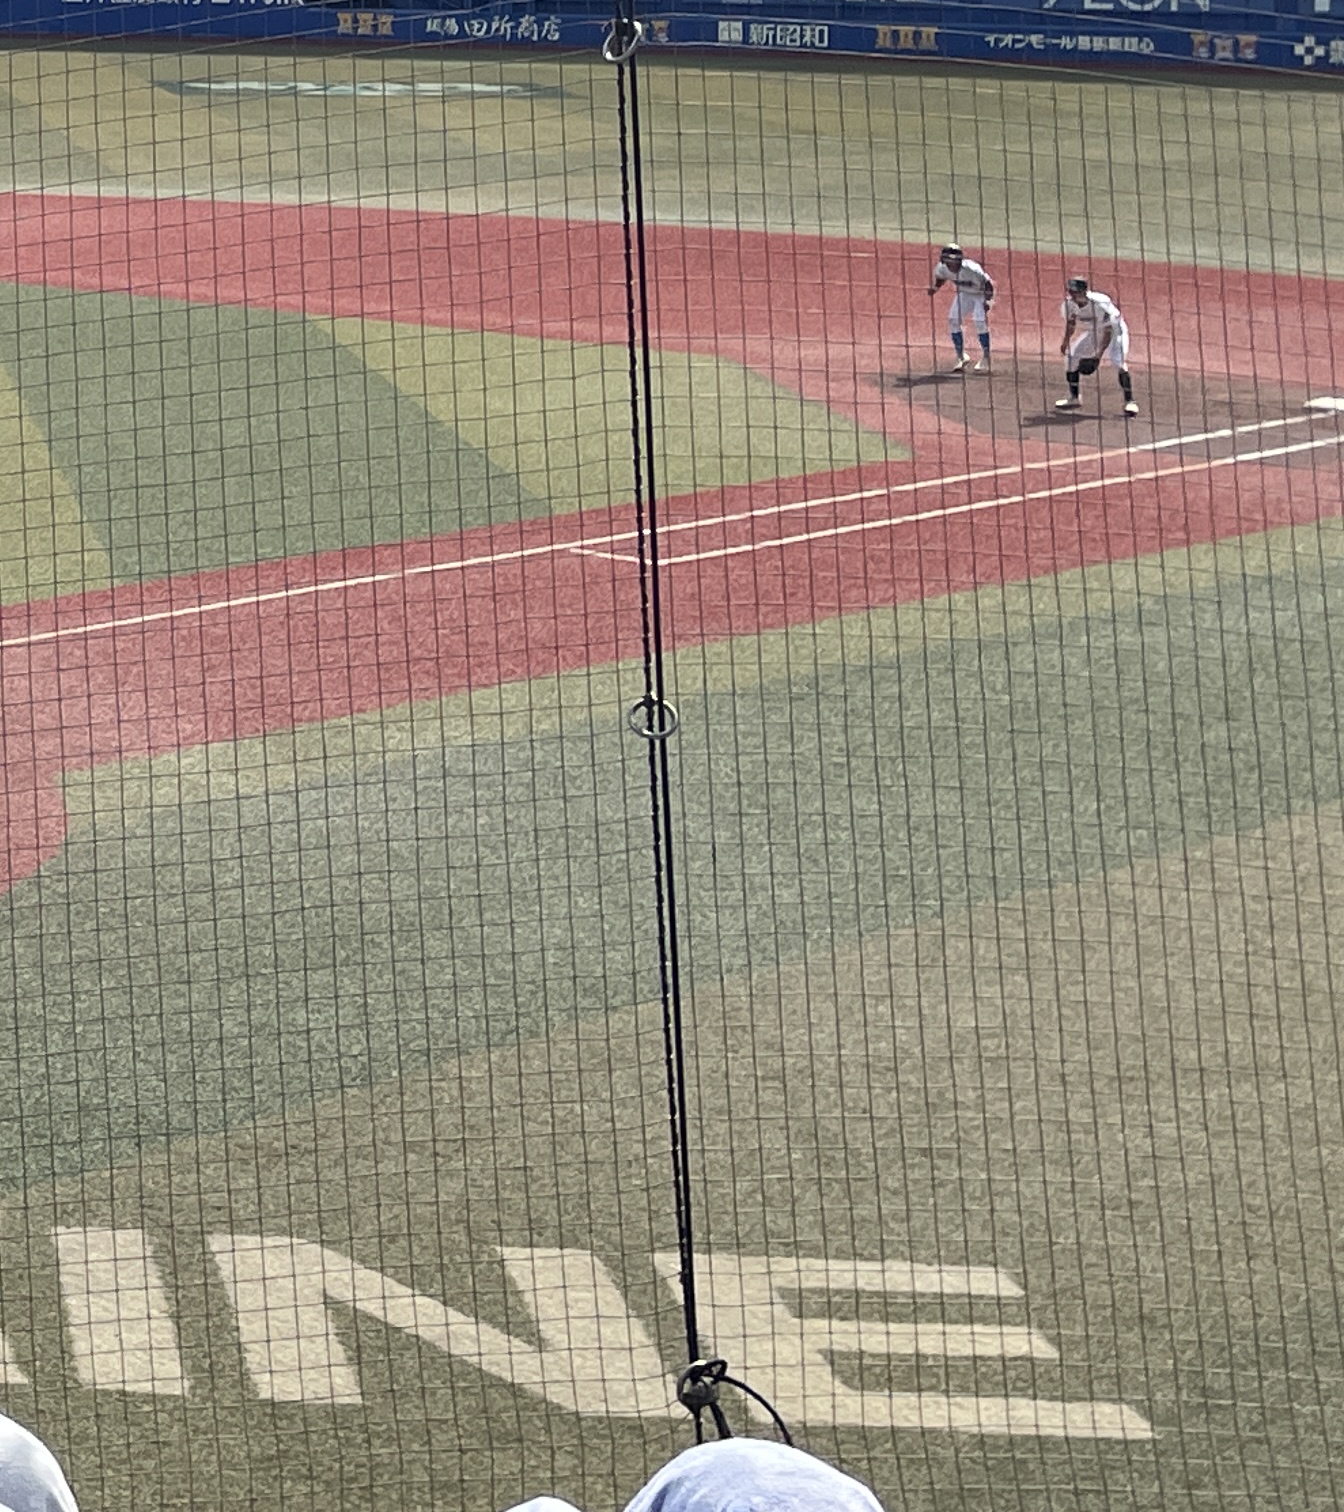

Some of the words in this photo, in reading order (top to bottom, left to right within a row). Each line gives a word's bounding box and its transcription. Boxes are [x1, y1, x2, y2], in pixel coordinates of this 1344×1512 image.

[464, 14, 561, 41] 田所商店
[749, 23, 829, 48] 新昭和
